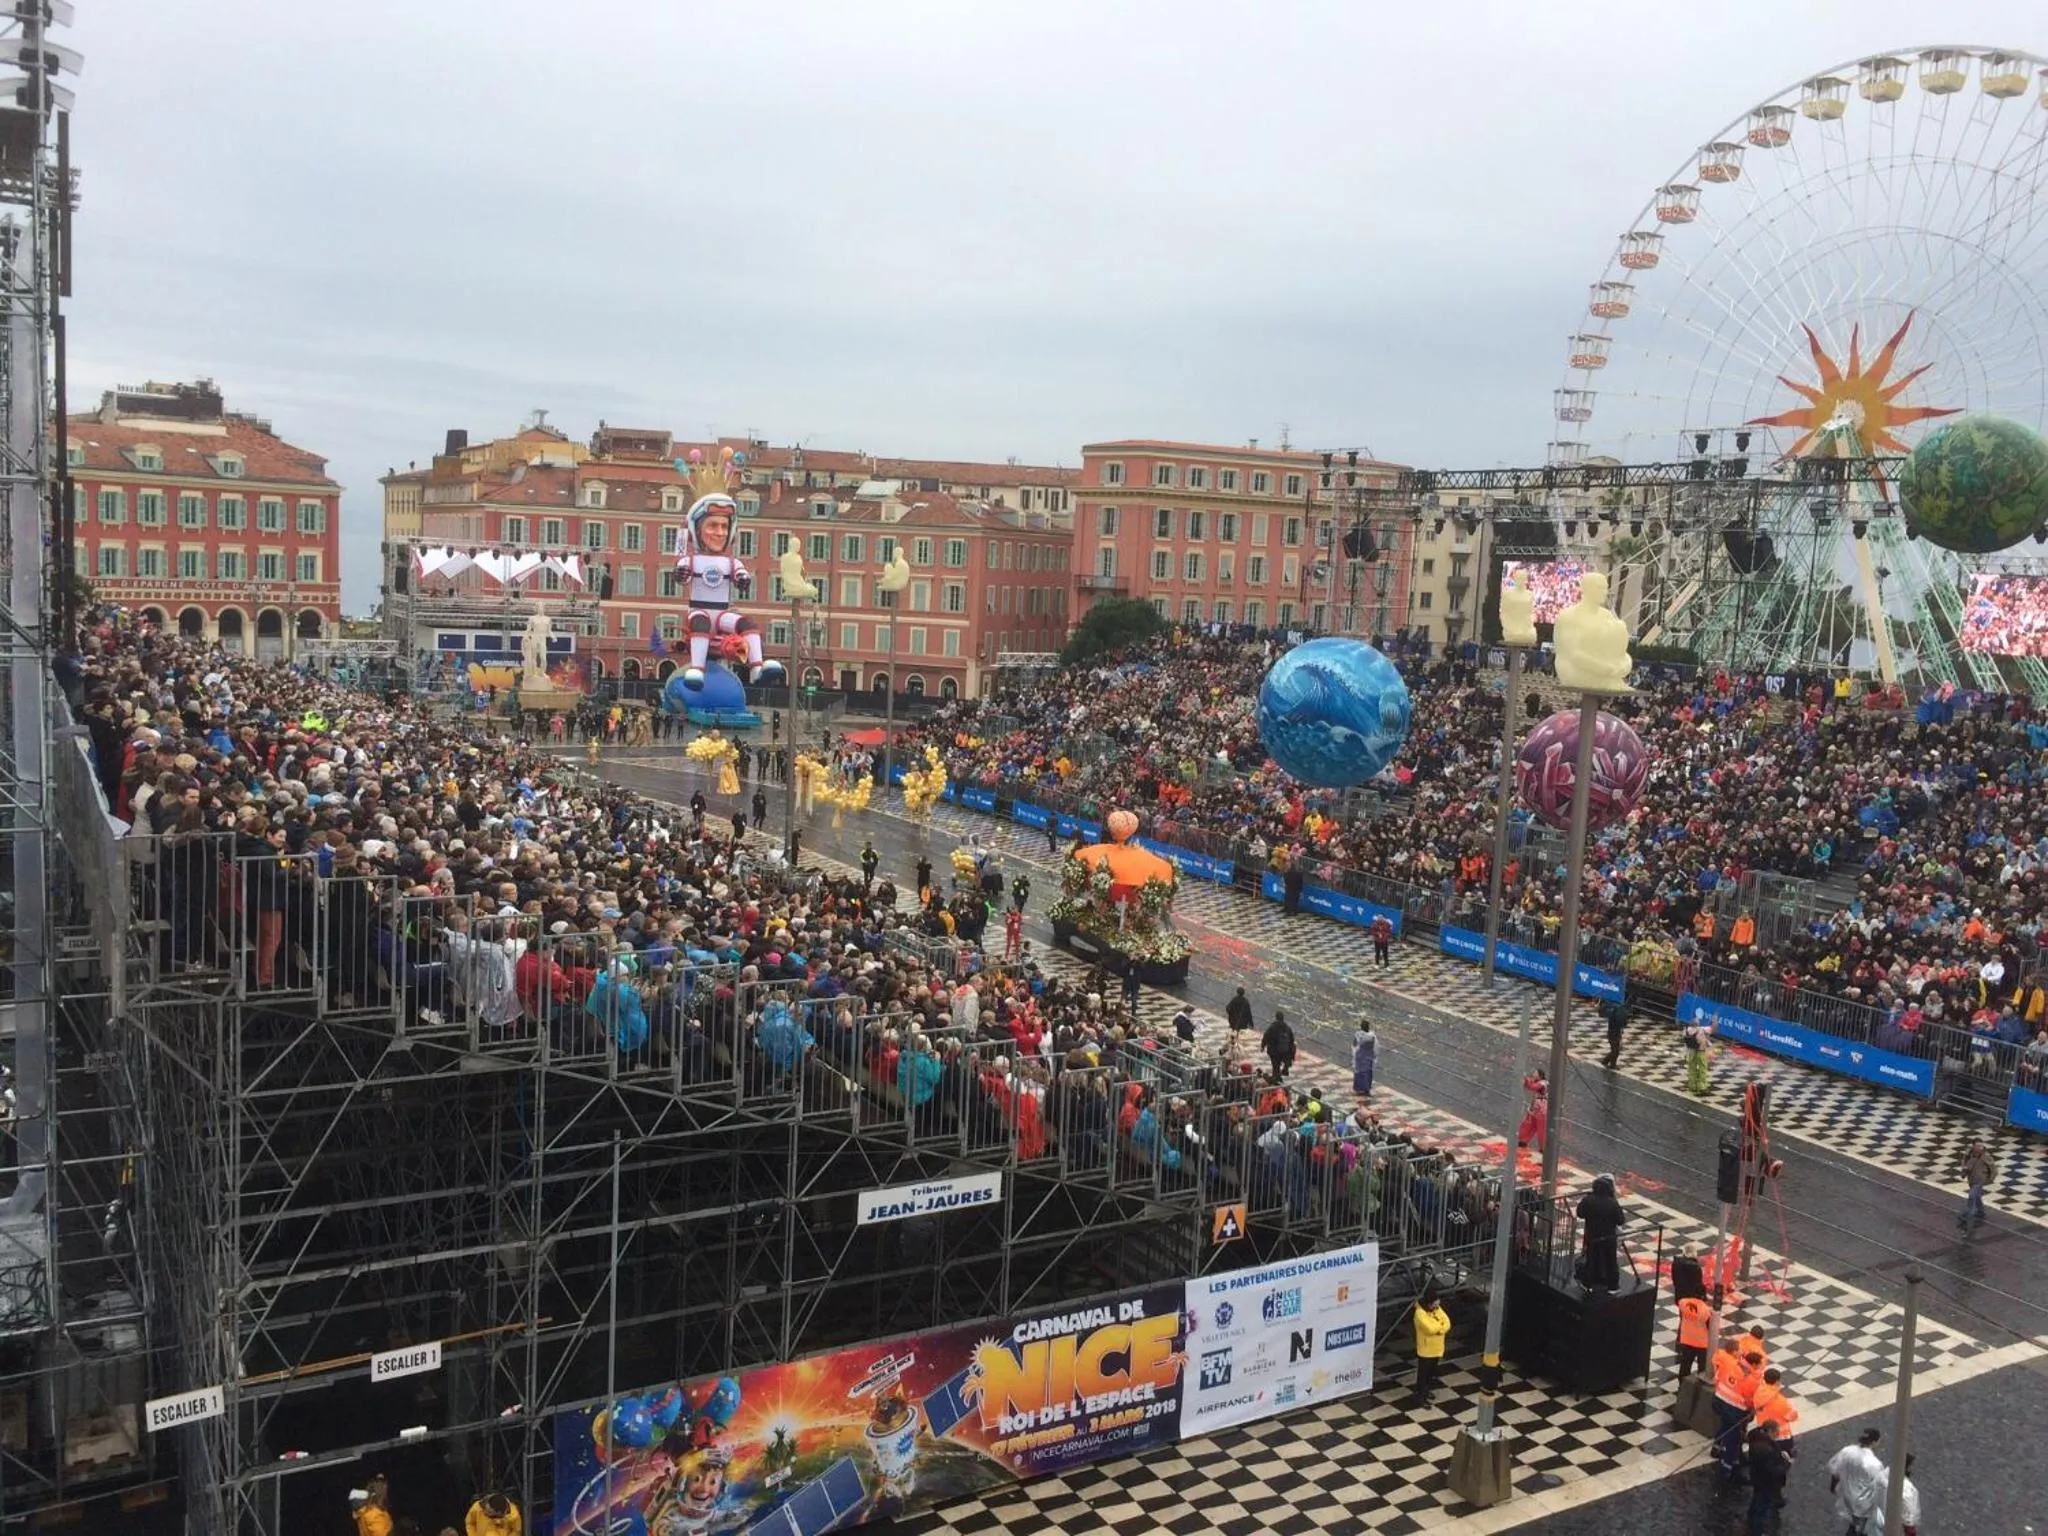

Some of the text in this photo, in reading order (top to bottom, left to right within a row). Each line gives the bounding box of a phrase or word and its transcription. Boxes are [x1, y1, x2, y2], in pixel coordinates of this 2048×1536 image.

[867, 1188, 993, 1220] JEAN-JAURES
[911, 1184, 953, 1197] Tribune
[1209, 1251, 1365, 1294] LES PARTENAIRES DU CARNAVAL
[1013, 1300, 1145, 1343] CARNAVAL DE
[377, 1349, 437, 1375] ESCALIER 1
[976, 1312, 1180, 1430] NICE
[1201, 1350, 1232, 1371] BFM
[1206, 1366, 1225, 1386] TV
[153, 1395, 218, 1425] ESCALIER 1
[998, 1382, 1156, 1434] ROI DE L'ESPACE
[1089, 1416, 1099, 1433] 3
[1099, 1406, 1146, 1428] MARS
[1145, 1399, 1177, 1419] 2018
[1032, 1429, 1129, 1461] NICECARNAVAL.COM
